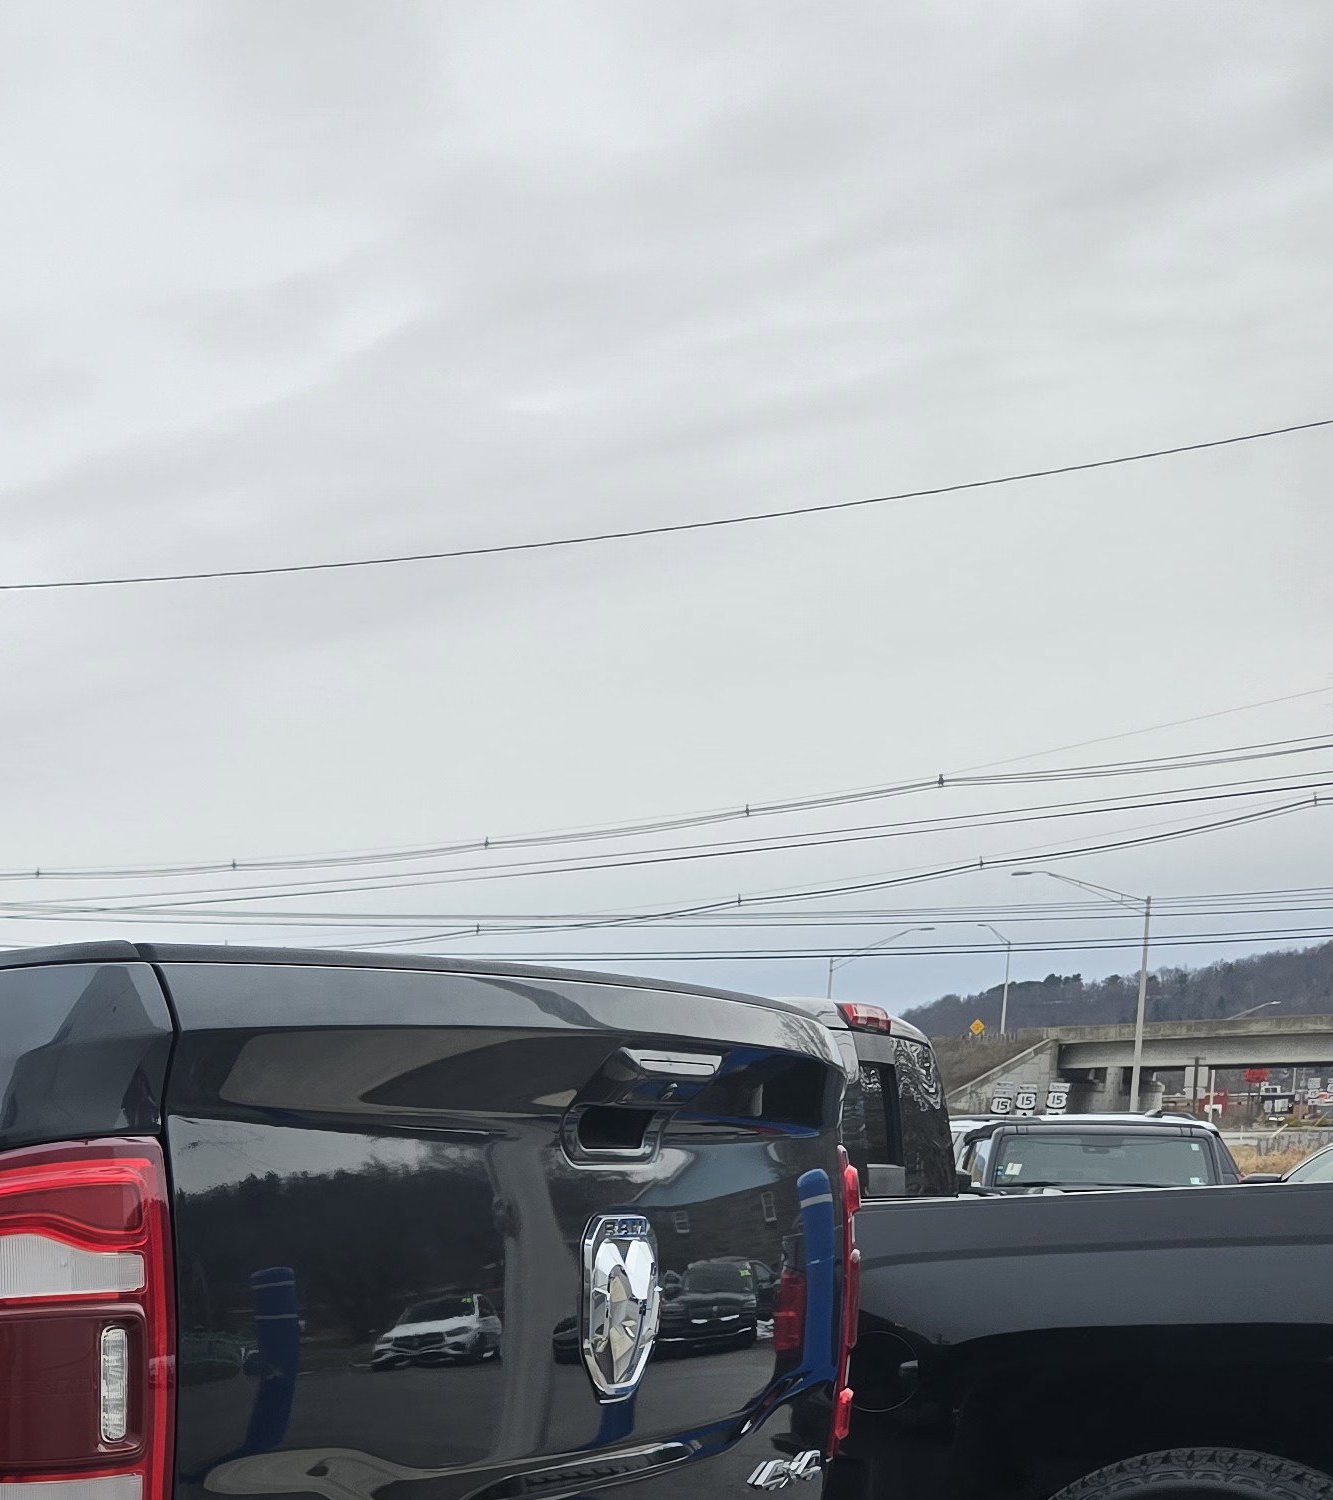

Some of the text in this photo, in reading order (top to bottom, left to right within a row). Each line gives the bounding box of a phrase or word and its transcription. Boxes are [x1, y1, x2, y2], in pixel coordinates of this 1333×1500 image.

[996, 1100, 1009, 1111] 15
[1022, 1095, 1033, 1106] 15
[1051, 1095, 1063, 1105] 15
[604, 1219, 646, 1235] RAM
